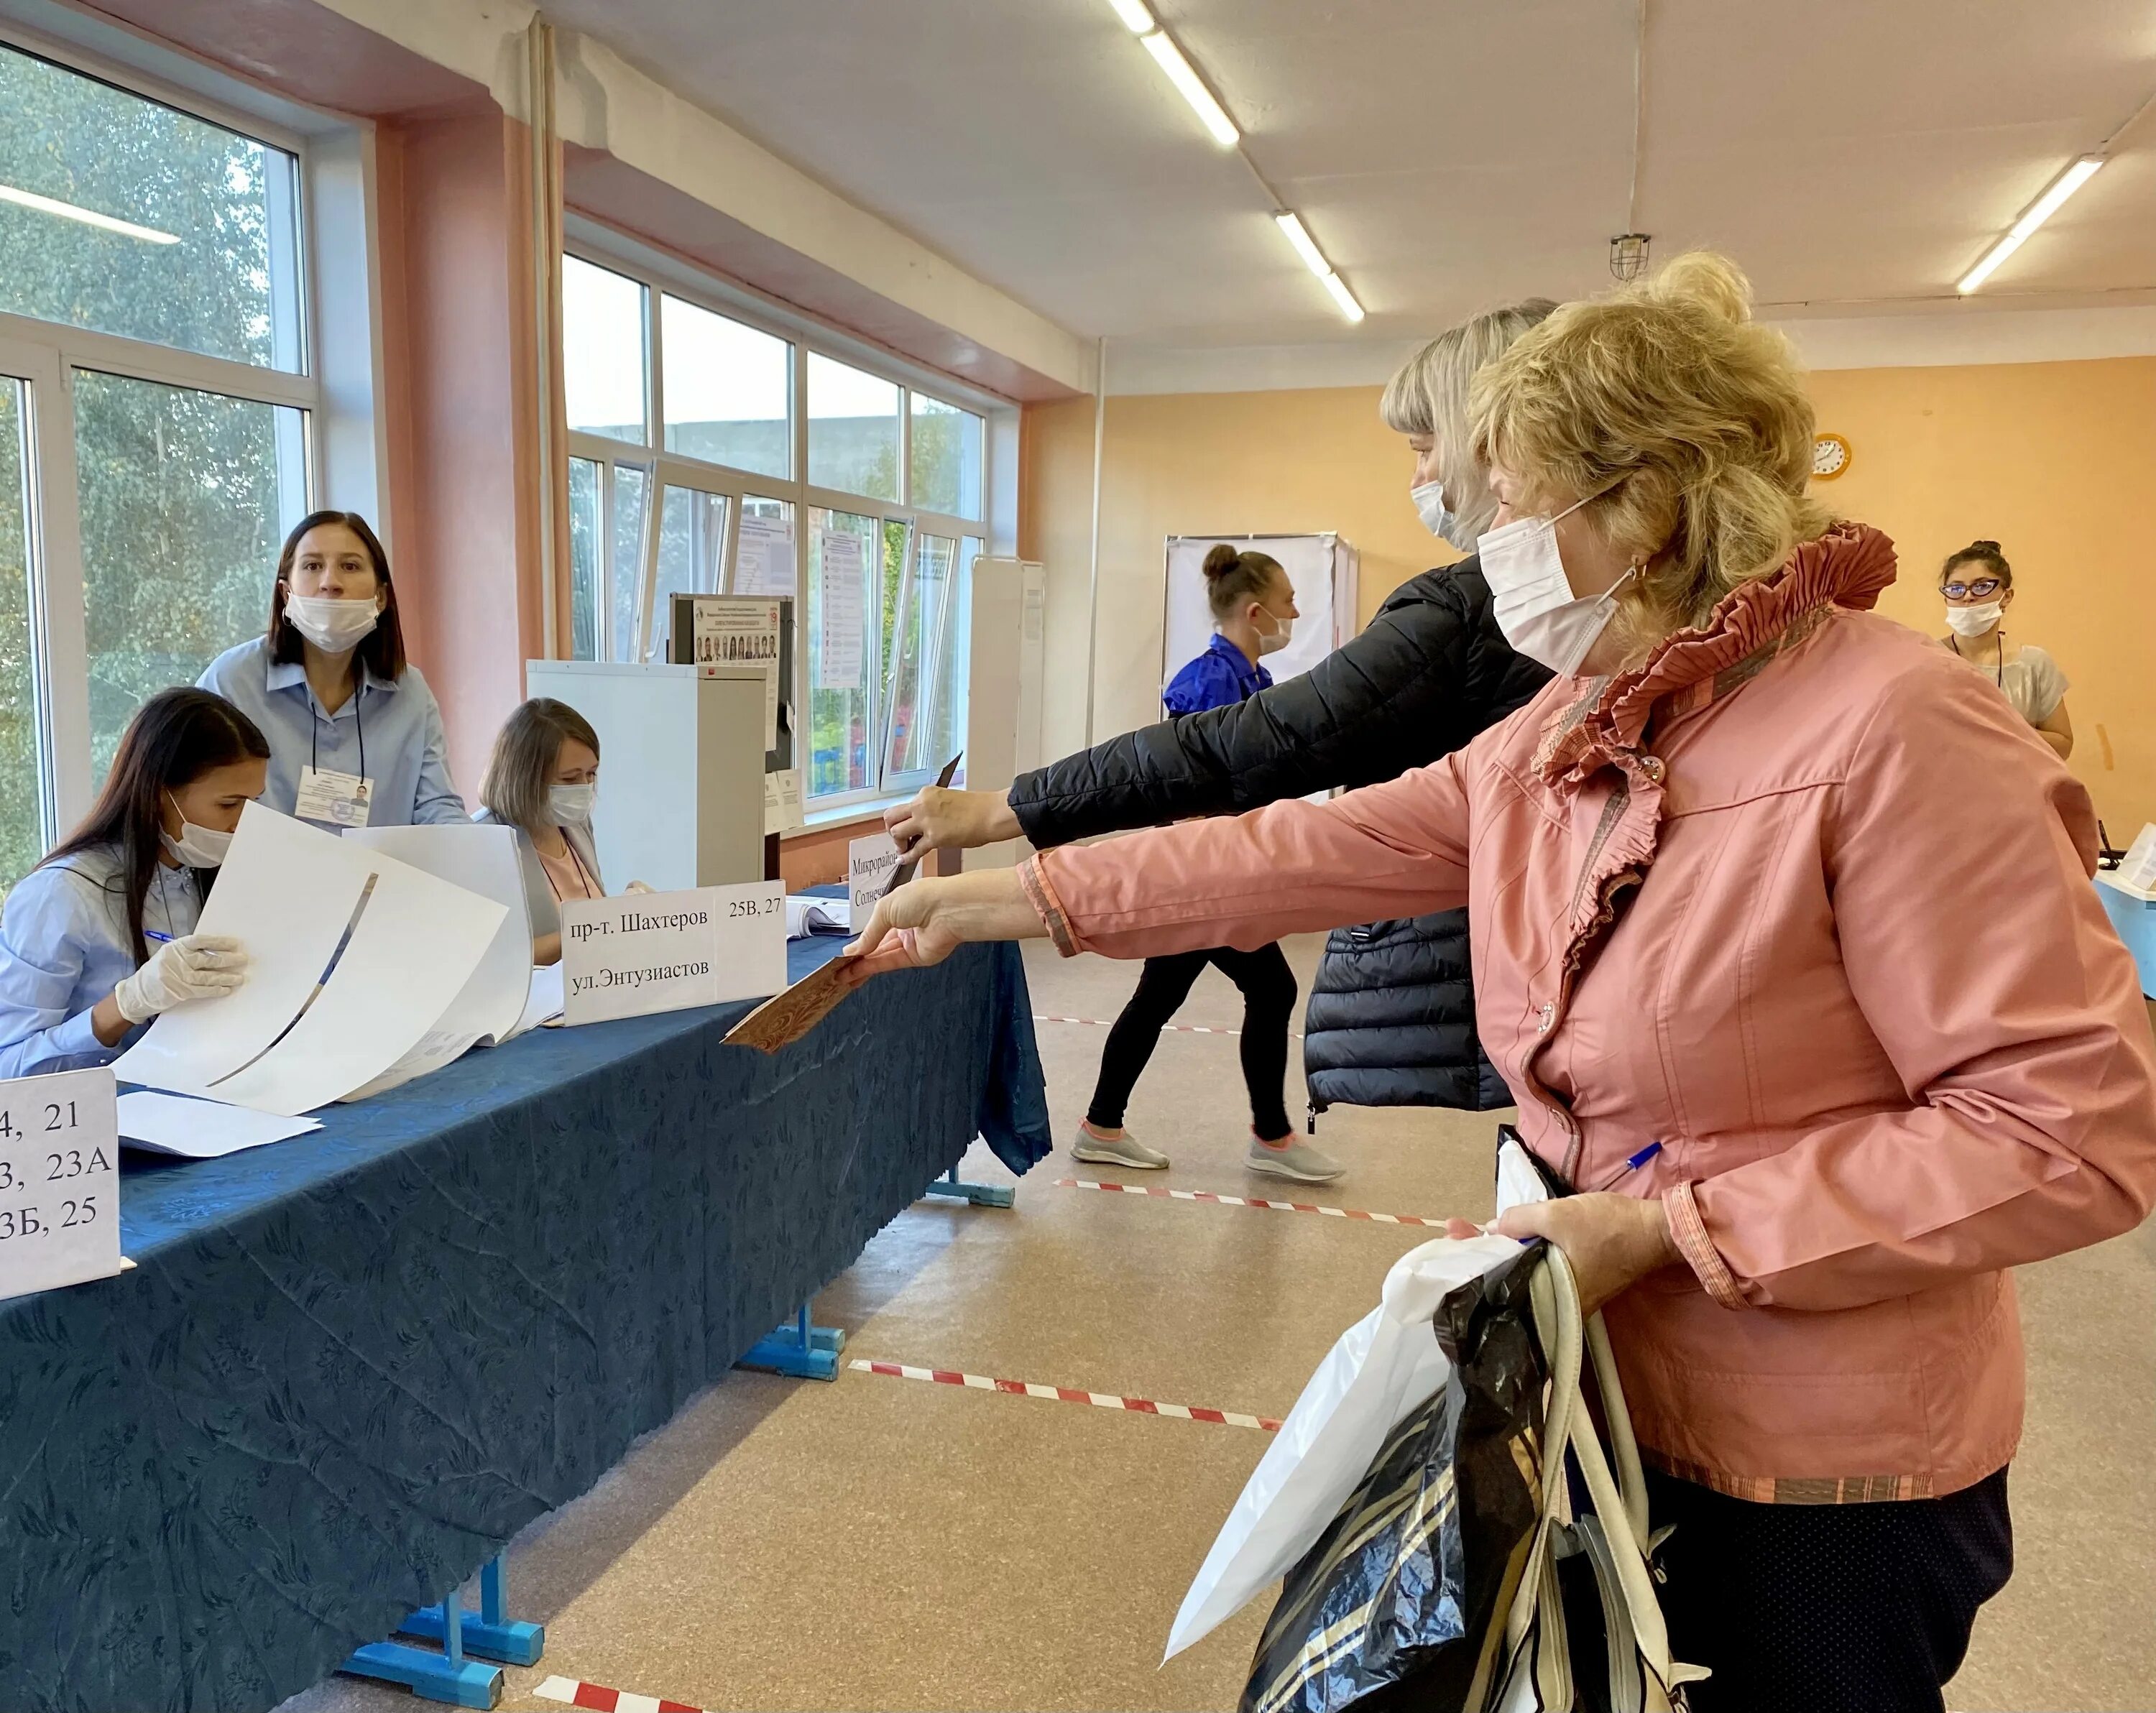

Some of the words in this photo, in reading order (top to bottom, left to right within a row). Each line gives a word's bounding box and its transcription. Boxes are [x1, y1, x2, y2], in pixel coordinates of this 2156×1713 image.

[570, 920, 614, 942] пр-т.
[621, 910, 708, 932] Шахтеров
[729, 900, 761, 918] 25В,
[765, 897, 781, 914] 27
[572, 961, 709, 996] ул.Энтузиастов
[45, 1101, 78, 1131] 21
[47, 1146, 112, 1181] 23А
[61, 1196, 96, 1227] 25
